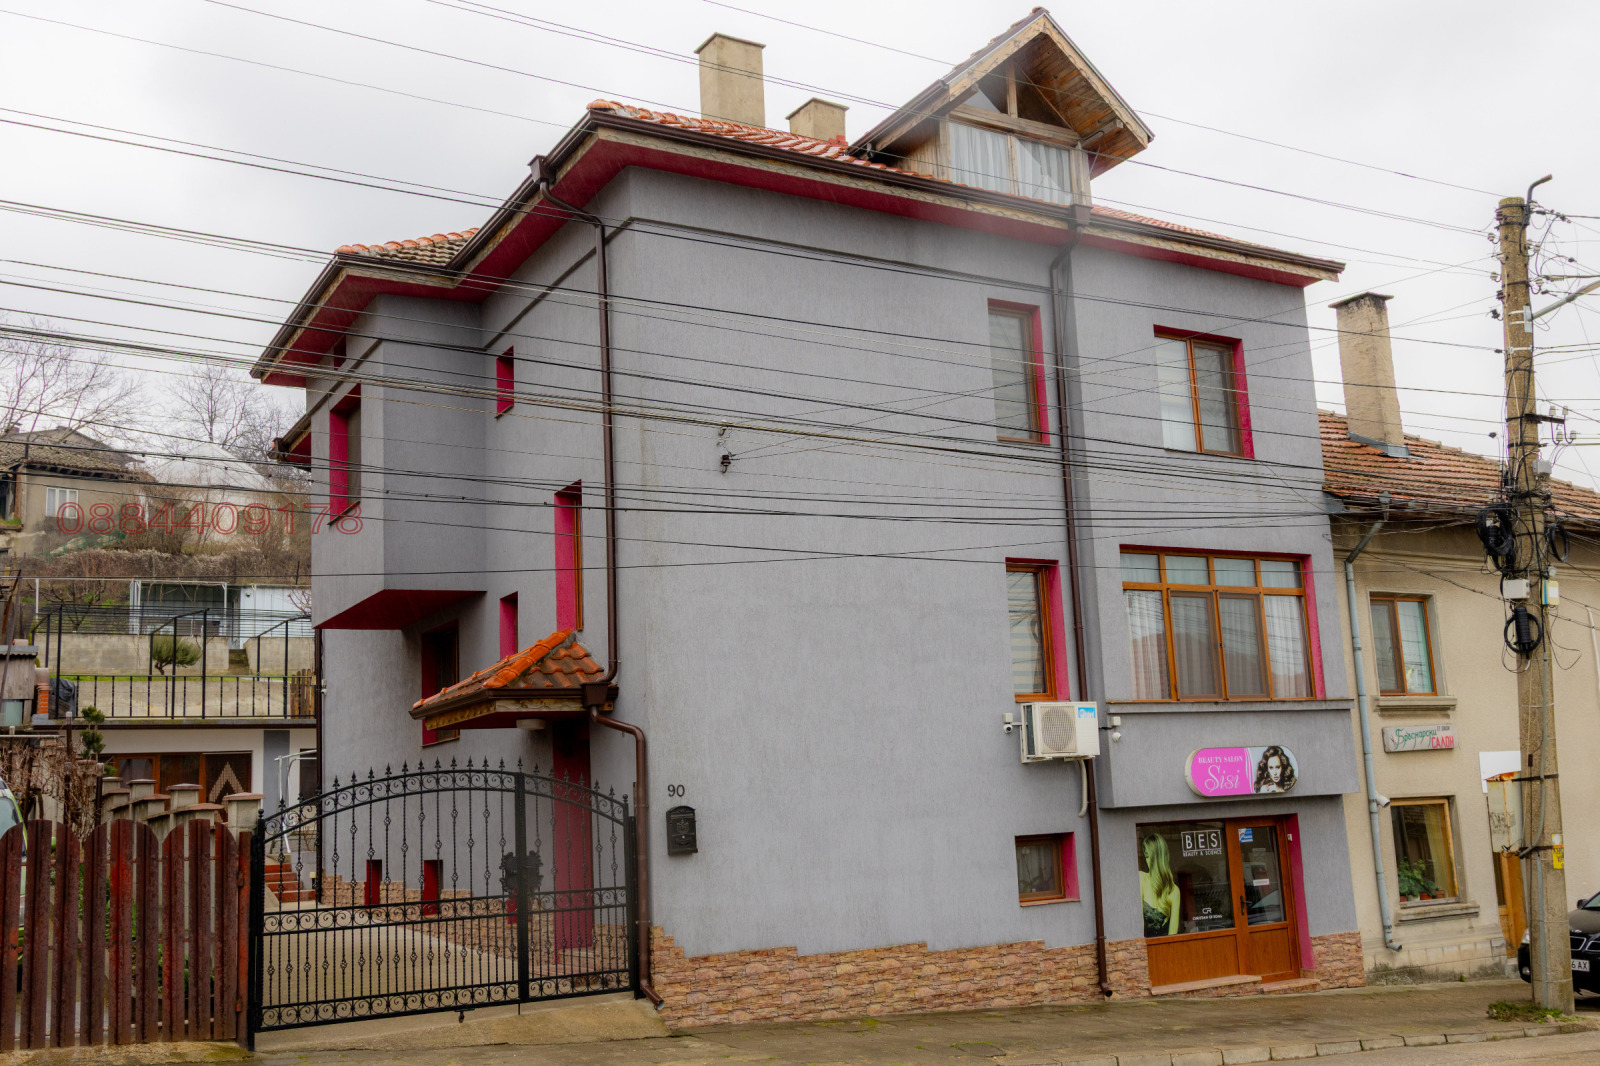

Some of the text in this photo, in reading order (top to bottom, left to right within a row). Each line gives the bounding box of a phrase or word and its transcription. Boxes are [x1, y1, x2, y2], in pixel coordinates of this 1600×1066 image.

[1431, 735, 1455, 749] САЛОН
[1198, 756, 1222, 764] BEAUTY
[1204, 764, 1240, 792] Sisi
[667, 784, 685, 797] 90
[1185, 832, 1218, 849] BES
[1577, 961, 1588, 970] AX
